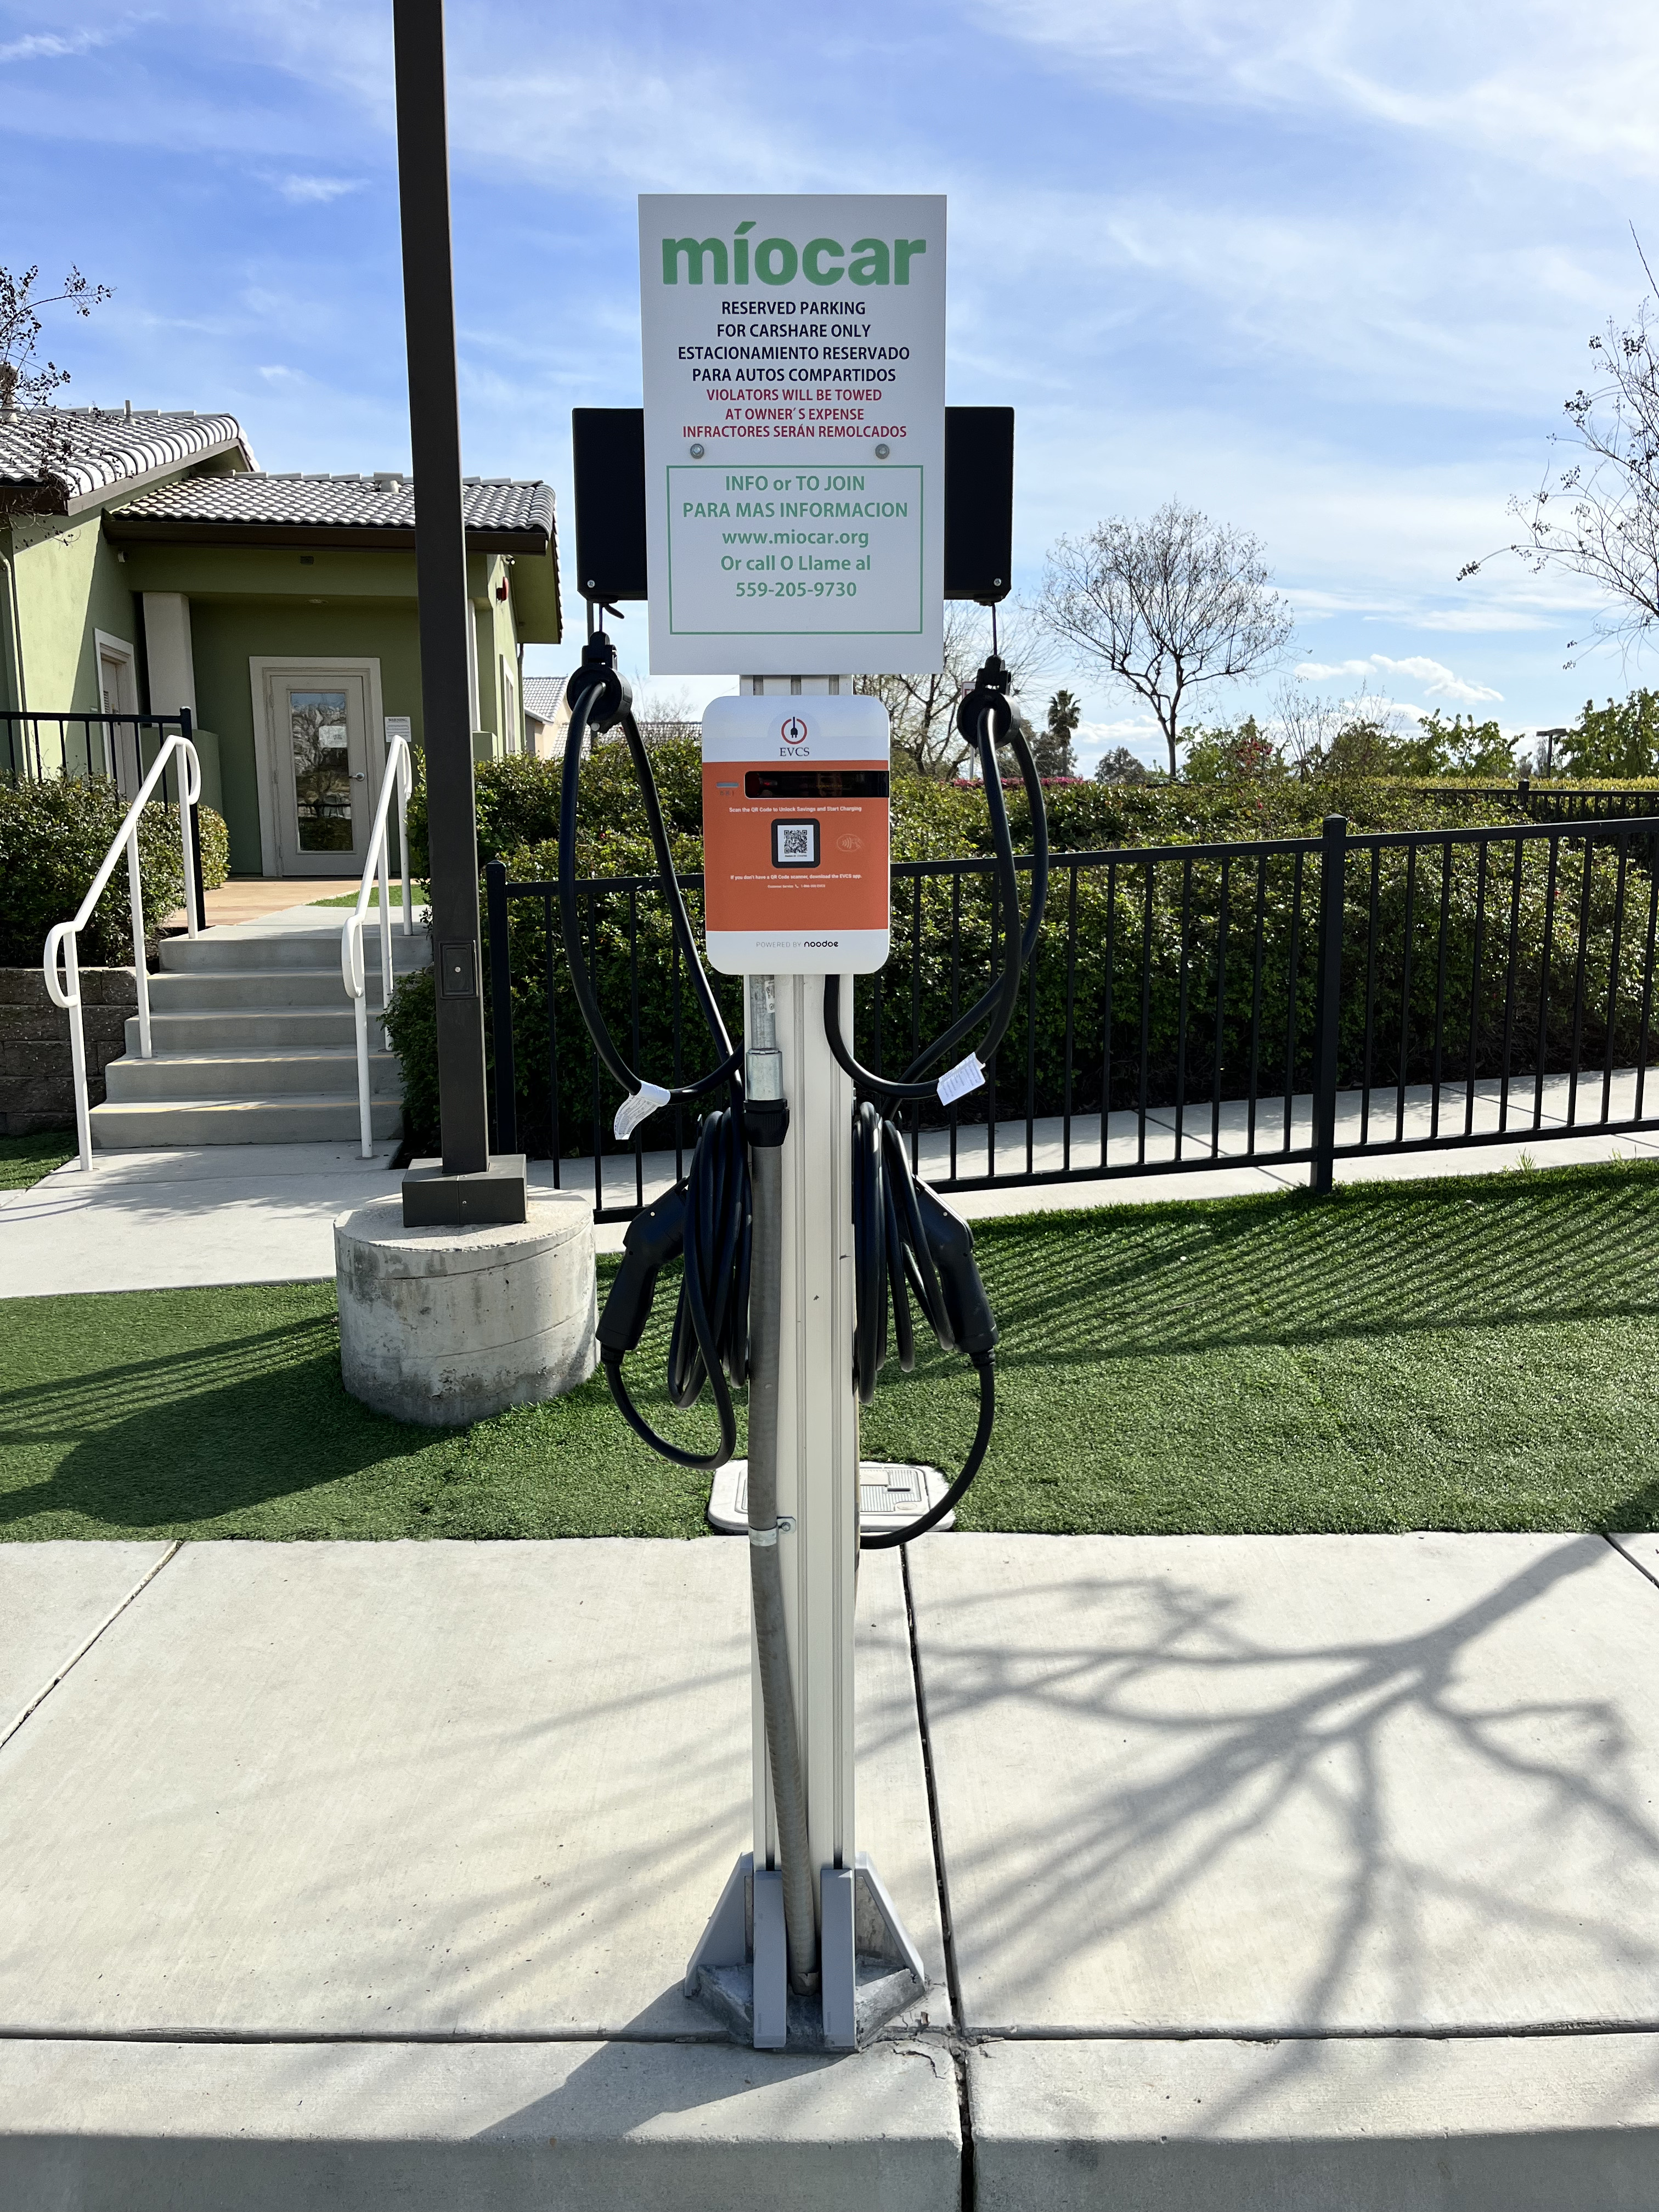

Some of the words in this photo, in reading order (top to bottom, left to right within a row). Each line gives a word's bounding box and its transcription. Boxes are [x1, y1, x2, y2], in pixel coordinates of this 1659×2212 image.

[662, 221, 927, 286] míocar
[721, 301, 796, 315] RESERVED
[800, 301, 866, 315] PARKING
[716, 324, 746, 337] FOR
[749, 324, 827, 338] CARSHARE
[830, 324, 871, 338] ONLY
[678, 346, 819, 360] ESTACIONAMIENTO
[822, 346, 910, 361] RESERVADO
[692, 368, 732, 382] PARA
[735, 368, 786, 382] AUTOS
[788, 368, 896, 382] COMPARTIDOS
[706, 388, 780, 402] VIOLATORS
[782, 389, 814, 402] WILL
[816, 389, 832, 401] BE
[834, 389, 882, 401] TOWED
[725, 408, 742, 420] AT
[809, 408, 865, 420] EXPENSE
[683, 426, 770, 438] INFRACTORES
[773, 423, 815, 438] SERÁN
[819, 426, 907, 438] REMOLCADOS
[726, 475, 769, 491] INFO
[773, 479, 792, 491] or
[795, 475, 820, 491] TO
[823, 475, 865, 491] JOIN
[683, 502, 731, 518] PARA
[736, 502, 775, 518] MAS
[780, 502, 908, 518] INFORMACION
[722, 529, 869, 548] www.miocar.org
[720, 555, 742, 571] Or
[746, 555, 775, 571] call
[780, 555, 793, 571] O
[799, 555, 851, 571] Llame
[855, 554, 871, 571] al
[736, 582, 857, 597] 559-205-9730
[779, 747, 810, 757] EVCS
